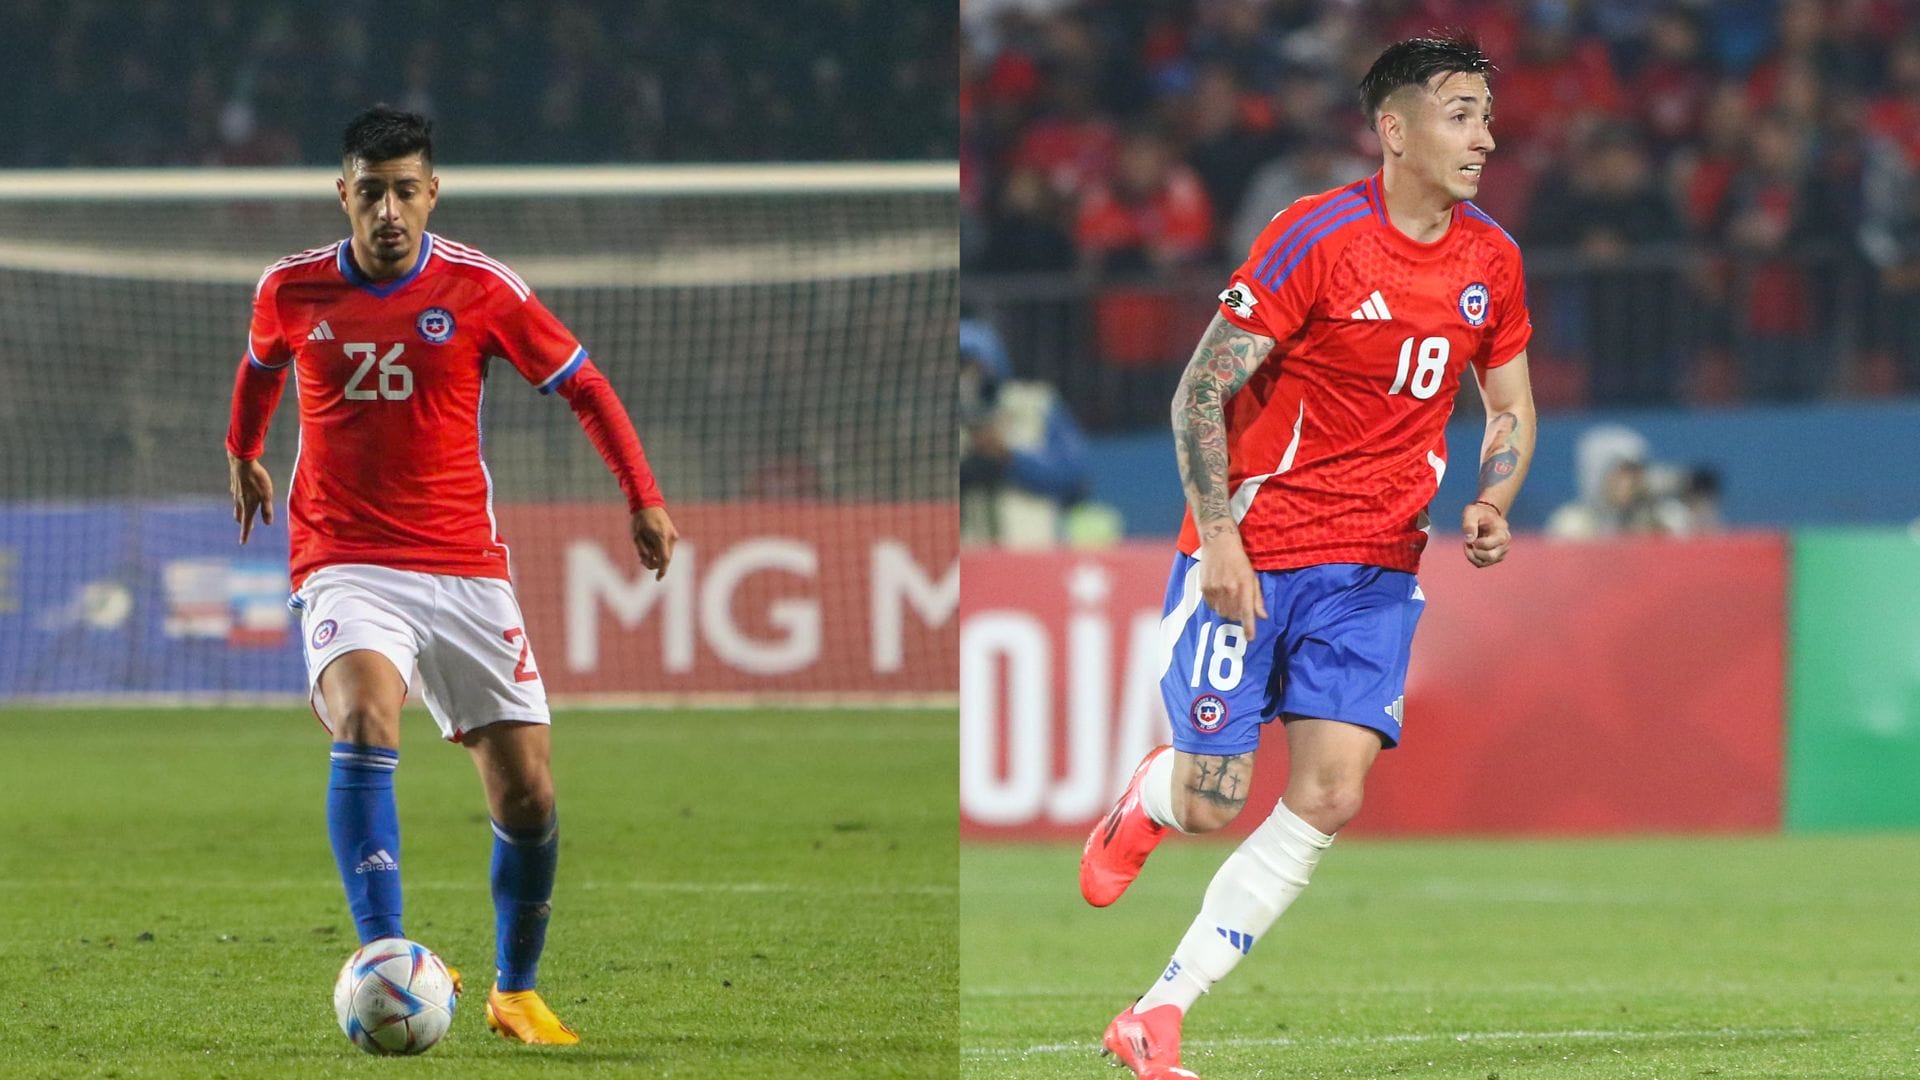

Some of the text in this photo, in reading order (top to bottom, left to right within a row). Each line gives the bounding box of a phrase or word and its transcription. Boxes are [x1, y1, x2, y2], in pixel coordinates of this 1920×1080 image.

[343, 343, 414, 400] 26
[1387, 336, 1450, 400] 18
[565, 537, 960, 675] MG M
[503, 627, 538, 683] 2
[1190, 621, 1248, 692] 18
